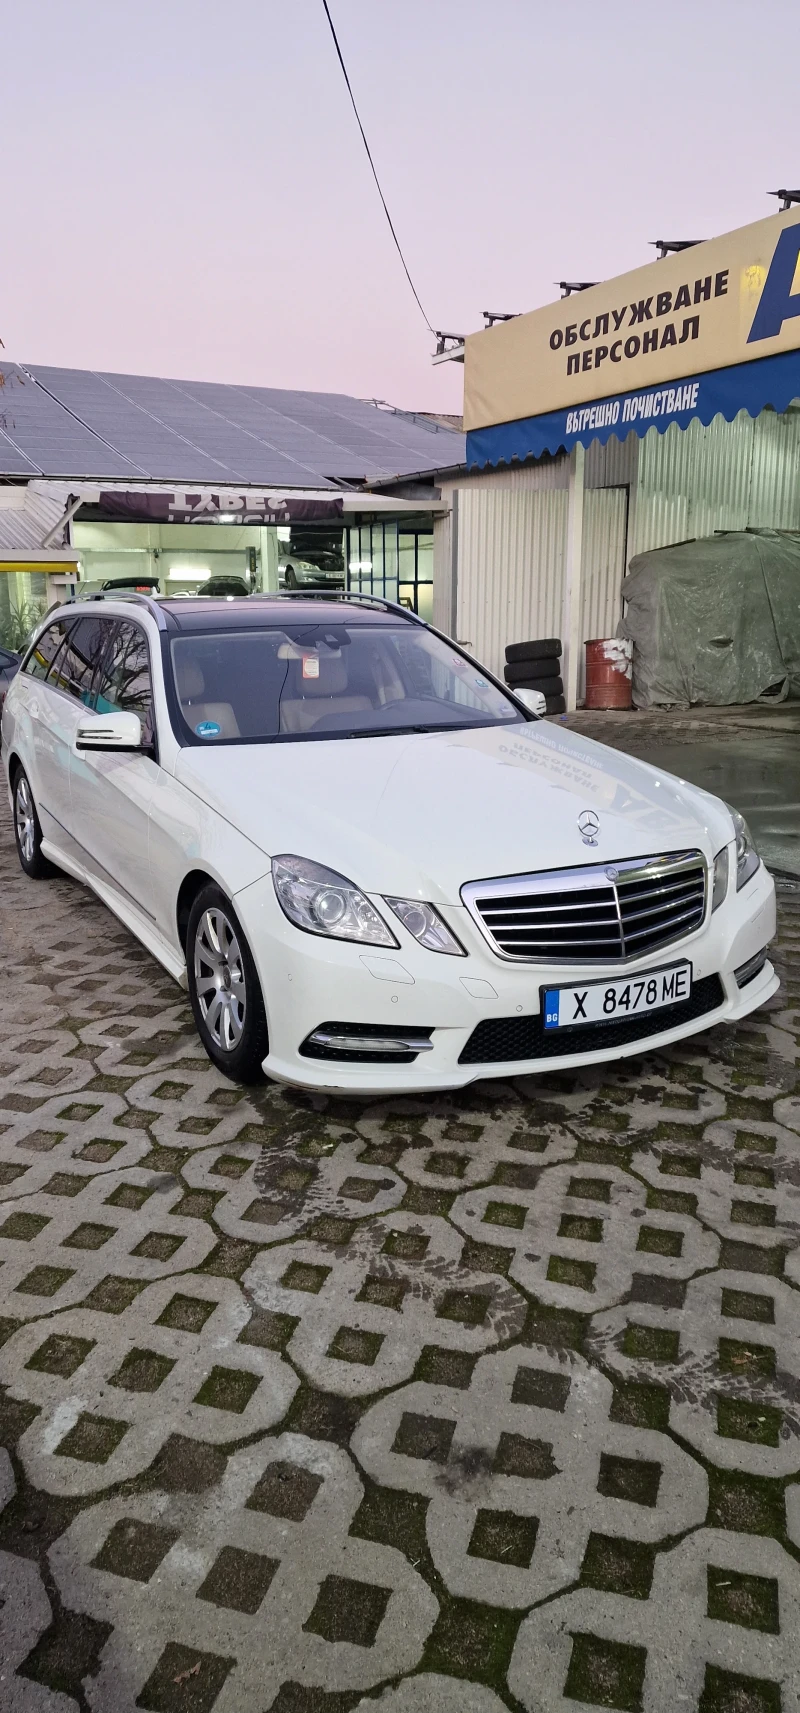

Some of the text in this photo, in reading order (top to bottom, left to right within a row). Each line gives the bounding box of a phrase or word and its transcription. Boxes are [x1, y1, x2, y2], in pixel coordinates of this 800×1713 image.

[549, 269, 729, 350] ОБСЛУЖВАНЕ
[566, 315, 700, 376] ПЕРСОНАЛ
[621, 383, 699, 423] ПОЧИСТВАНЕ
[546, 1013, 558, 1023] BG
[572, 969, 687, 1020] X 8478 ME
